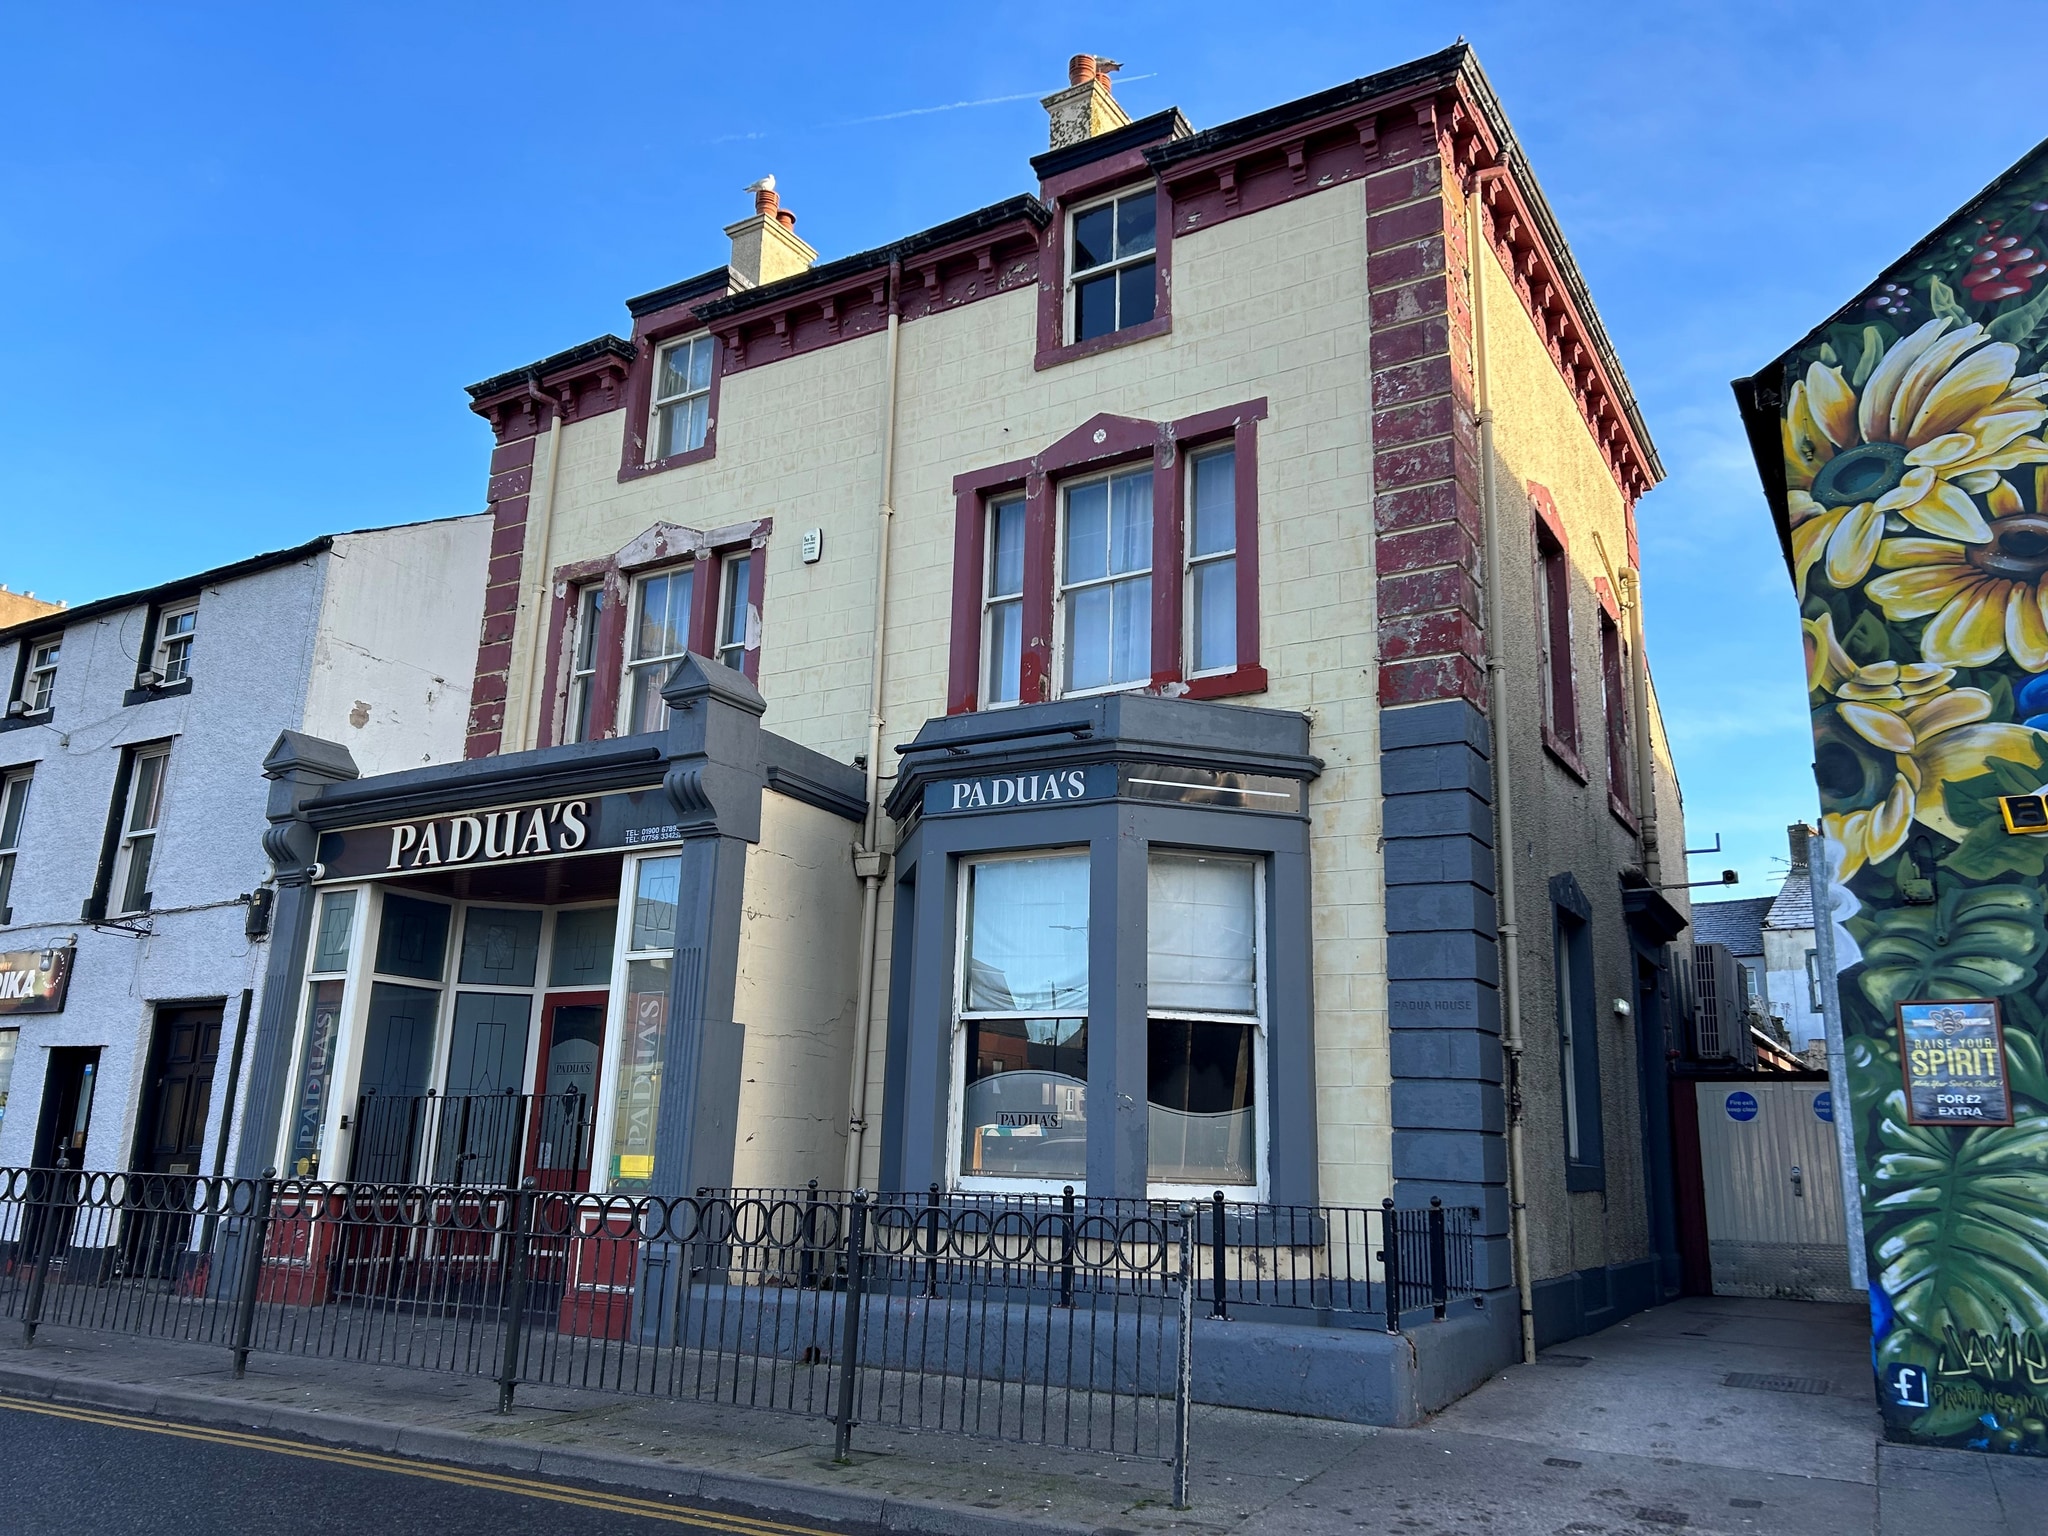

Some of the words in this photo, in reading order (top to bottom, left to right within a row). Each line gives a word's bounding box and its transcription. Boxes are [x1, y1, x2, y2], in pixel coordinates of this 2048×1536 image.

[951, 771, 1085, 809] PADUA'S
[387, 801, 586, 869] PADUA'S
[625, 829, 639, 837] TEL:
[641, 827, 659, 835] 01900
[661, 824, 679, 832] 6789
[625, 836, 639, 844] TEL:
[1394, 1000, 1432, 1011] PADUA
[1434, 1000, 1472, 1010] HOUSE
[1914, 1038, 1952, 1049] RAISE
[1959, 1037, 1992, 1048] YOUR
[556, 1063, 591, 1073] PADUA'S
[1911, 1048, 1998, 1076] SPIRIT
[300, 1012, 332, 1144] PADUA'S
[628, 1000, 660, 1146] PADUA'S
[1937, 1094, 1964, 1104] FOR
[1966, 1094, 1982, 1104] £2
[1938, 1107, 1983, 1116] EXTRA
[1000, 1114, 1058, 1127] PADUA'S
